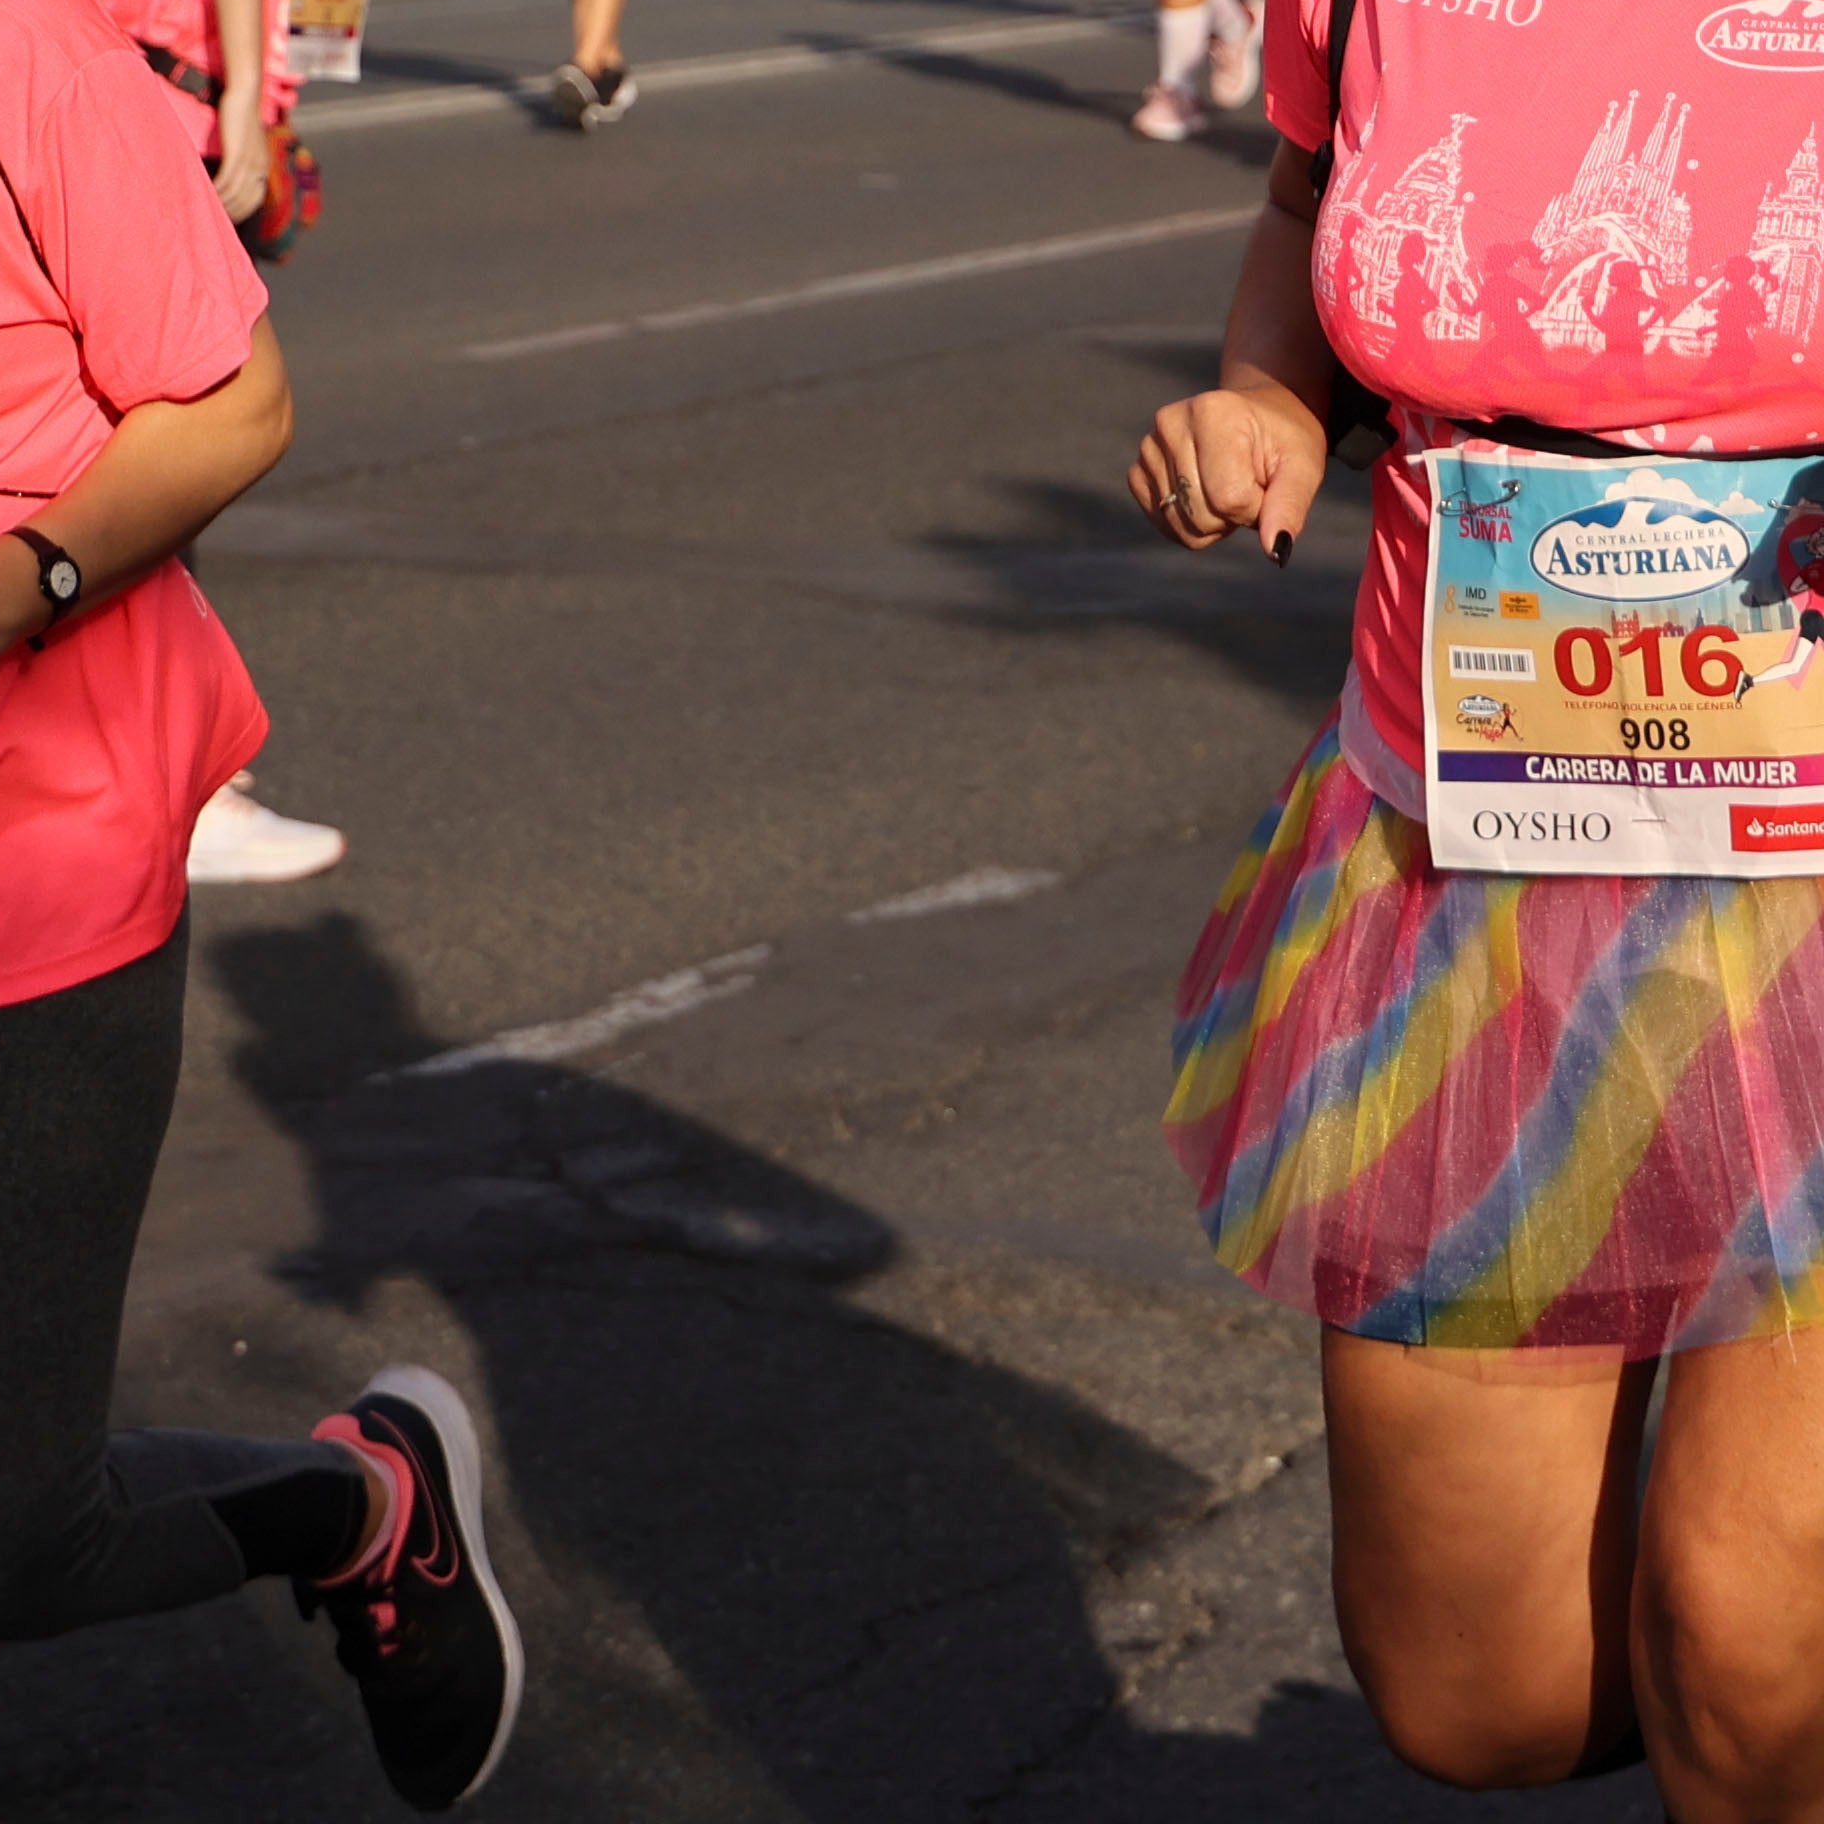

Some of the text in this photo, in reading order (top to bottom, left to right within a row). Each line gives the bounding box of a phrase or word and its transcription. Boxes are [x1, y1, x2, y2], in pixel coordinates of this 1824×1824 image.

[1741, 18, 1798, 31] CENTRAL
[1458, 516, 1512, 543] SUMA
[1576, 527, 1725, 546] CENTRAL LECHERA
[1546, 537, 1736, 576] ASTURIANA
[1465, 586, 1487, 600] IMD
[1554, 625, 1743, 696] 016
[1620, 702, 1677, 712] VIOLENCIA
[1680, 702, 1694, 711] DE
[1620, 718, 1690, 751] 908
[1526, 755, 1797, 785] CARRERA DE LA MUJER
[1472, 810, 1611, 842] OYSHO
